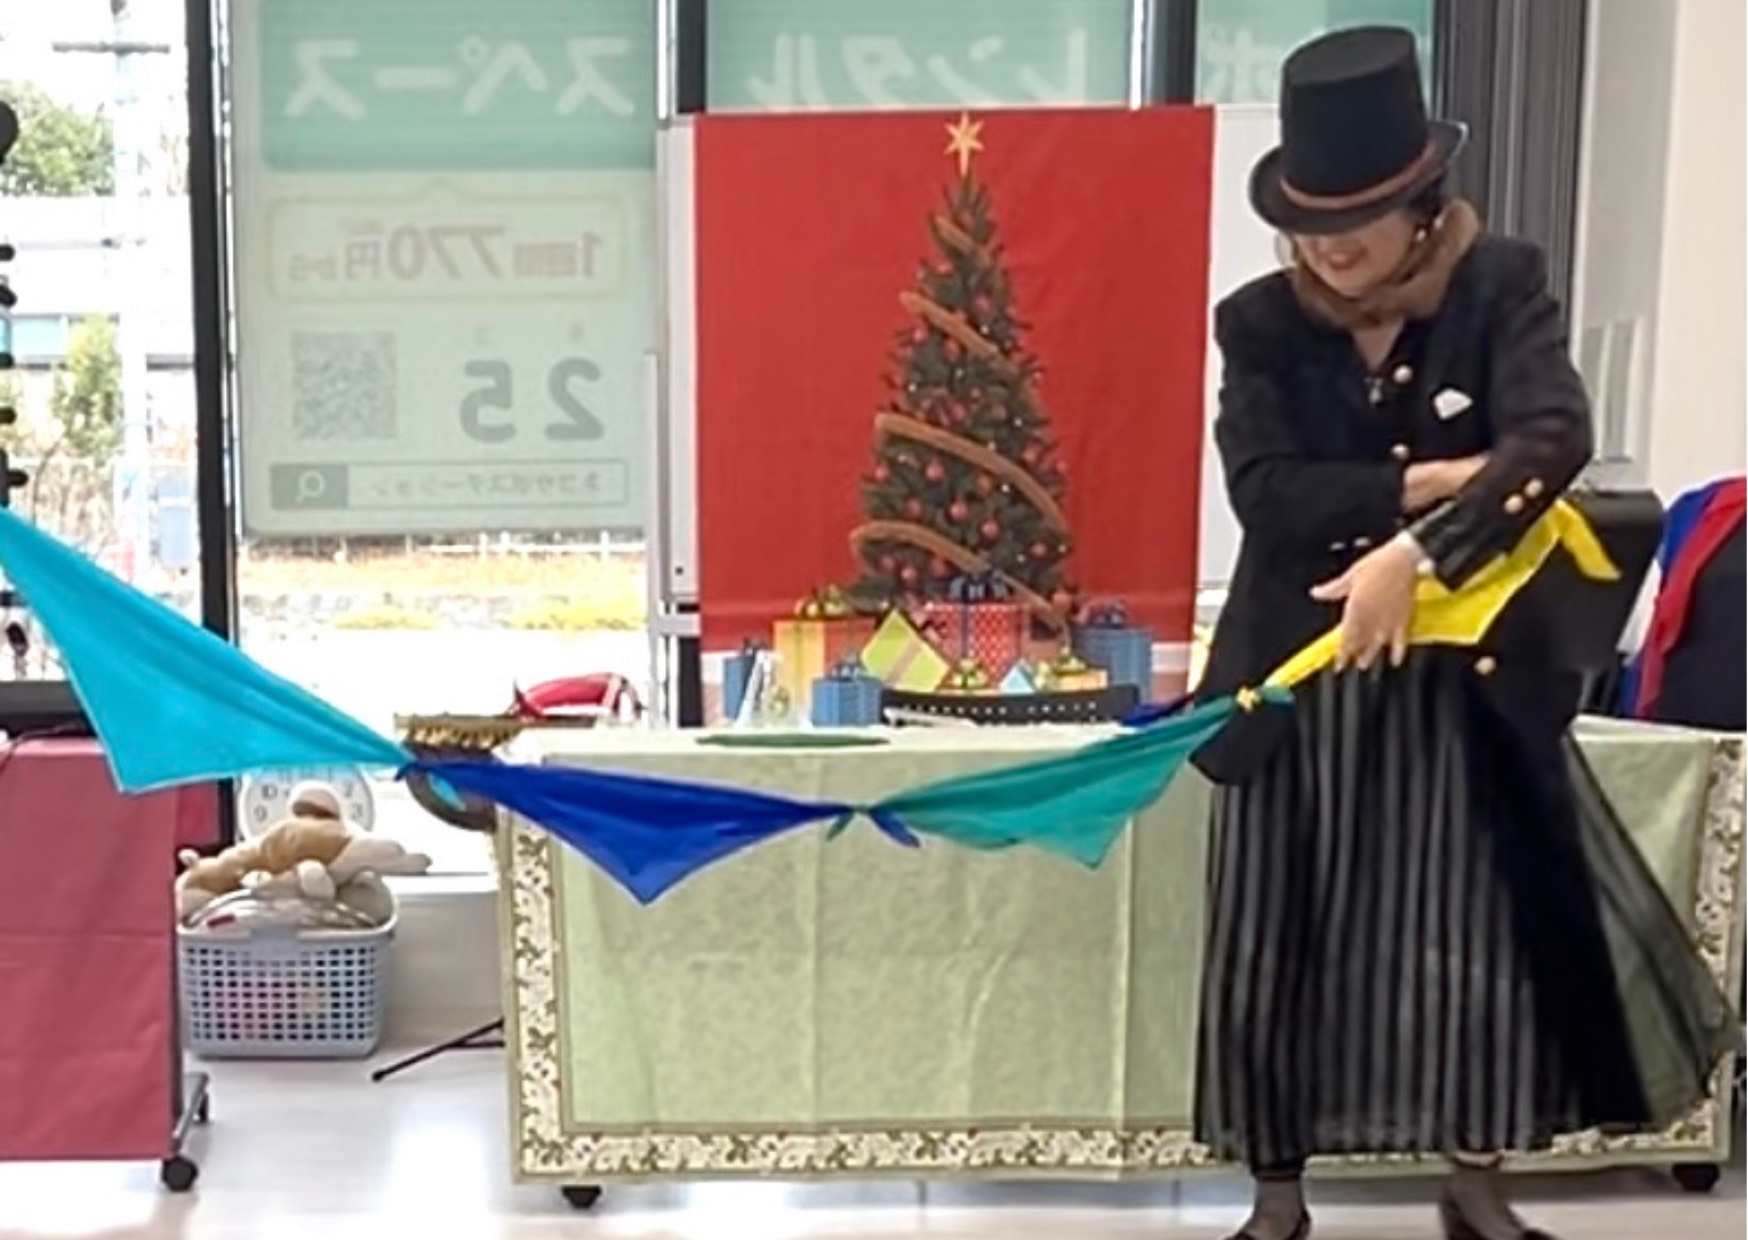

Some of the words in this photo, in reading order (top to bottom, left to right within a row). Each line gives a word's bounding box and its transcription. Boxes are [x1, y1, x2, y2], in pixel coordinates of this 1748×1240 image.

[261, 784, 278, 799] 10
[253, 805, 268, 822] 9
[351, 803, 363, 821] 3
